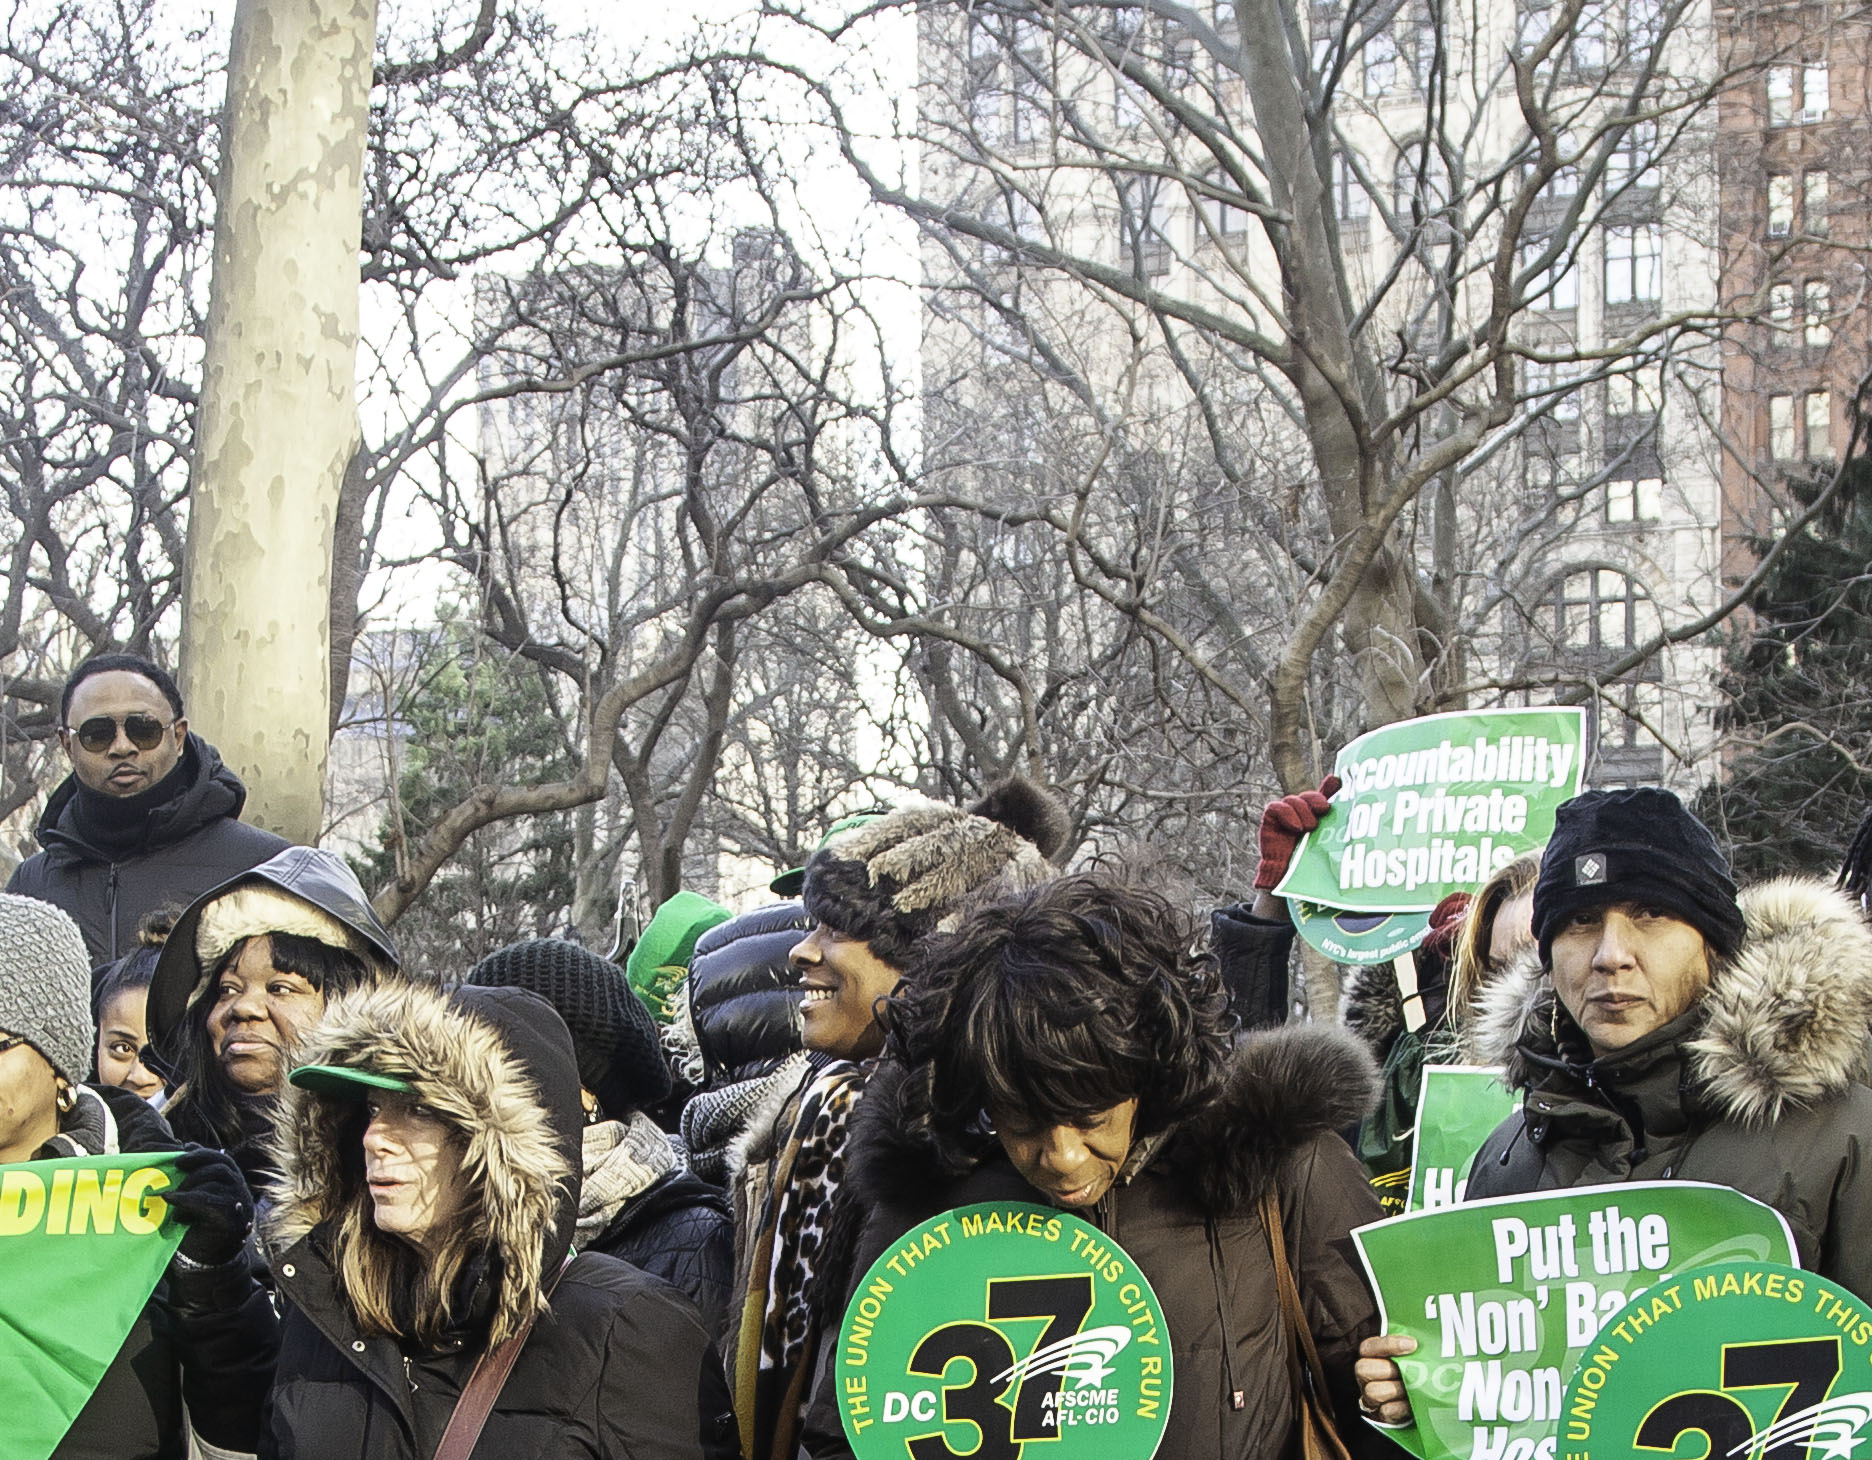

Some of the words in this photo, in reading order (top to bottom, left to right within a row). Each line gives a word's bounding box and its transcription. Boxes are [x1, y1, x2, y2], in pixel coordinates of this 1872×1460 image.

[1392, 788, 1528, 835] Private
[1380, 939, 1409, 959] public
[887, 1223, 952, 1276] THAT
[961, 1211, 1062, 1241] MAKES
[1492, 1213, 1579, 1284] Put
[1587, 1206, 1670, 1278] the
[1070, 1228, 1124, 1283] THIS
[846, 1277, 893, 1366] UNION
[1119, 1283, 1159, 1346] CITY
[1565, 1273, 1674, 1349] Ba
[1566, 1345, 1619, 1440] UNION
[1611, 1285, 1682, 1344] THAT
[1693, 1271, 1805, 1303] MAKES
[847, 1376, 874, 1435] THE
[882, 1390, 937, 1423] DC
[1041, 1389, 1119, 1408] AFSCME
[1137, 1356, 1162, 1419] RUN
